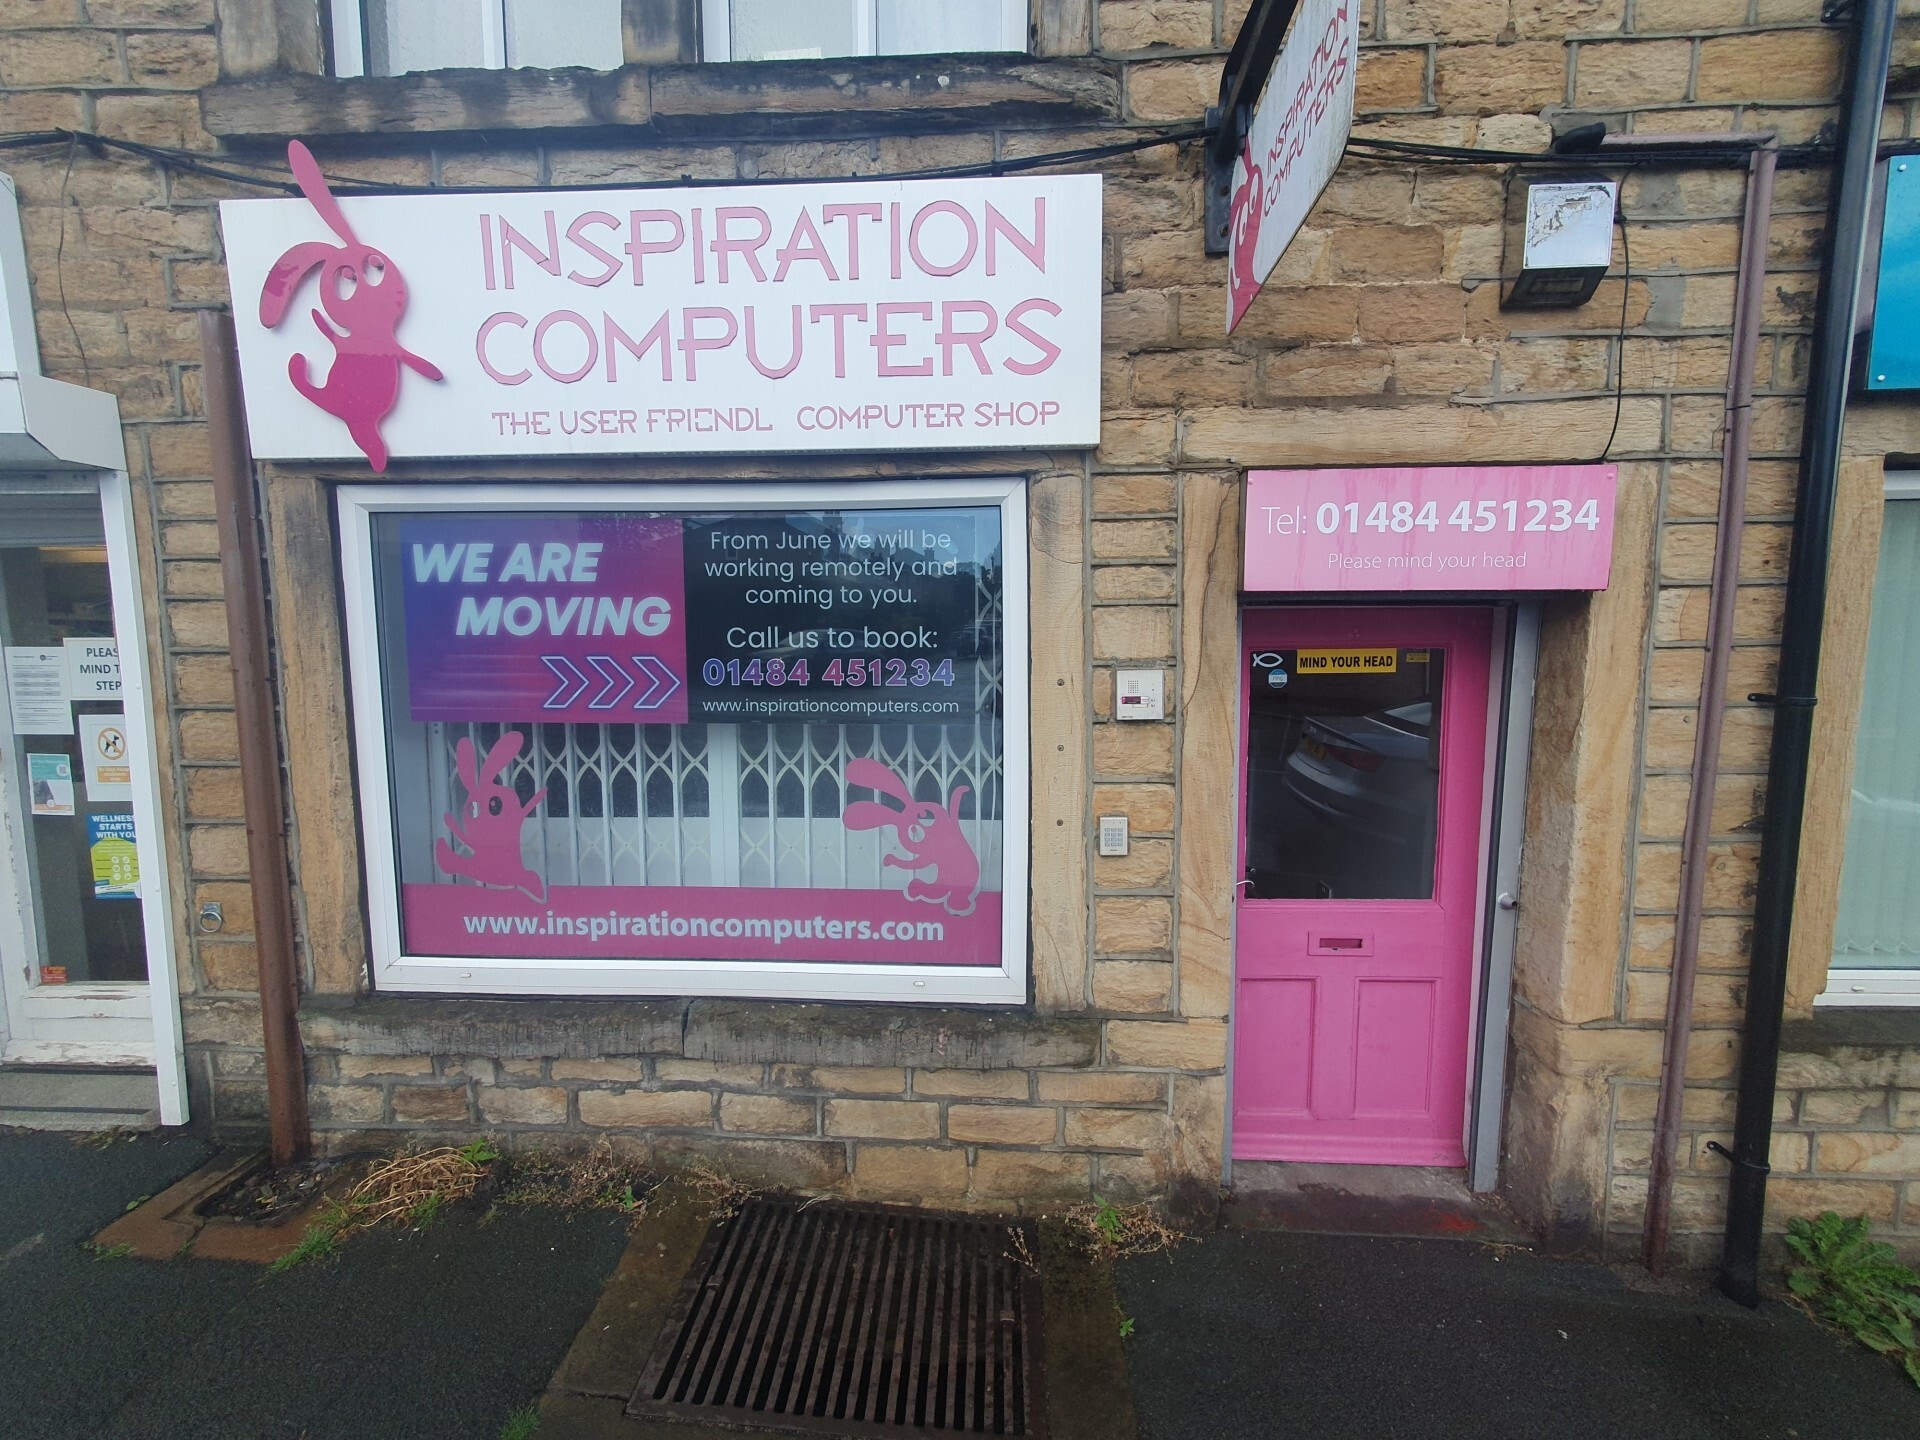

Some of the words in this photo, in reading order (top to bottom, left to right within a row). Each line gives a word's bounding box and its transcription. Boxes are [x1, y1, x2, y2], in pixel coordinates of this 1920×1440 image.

[1266, 0, 1349, 178] INSPIRATION
[1263, 36, 1349, 218] COMPUTERS
[480, 197, 1046, 290] INSPIRATION
[476, 298, 1063, 385] COMPUTERS
[491, 411, 551, 435] THE
[559, 409, 638, 434] USER
[797, 403, 965, 430] COMPUTER
[974, 401, 1060, 427] SHOP
[1261, 506, 1308, 535] Tel:
[1316, 501, 1440, 534] 01484
[1447, 499, 1600, 532] 451234
[710, 531, 768, 549] From
[776, 531, 831, 549] June
[839, 536, 871, 549] we
[879, 529, 914, 548] will
[922, 530, 951, 548] be
[412, 543, 494, 582] WE
[498, 543, 603, 582] ARE
[704, 558, 794, 582] working
[801, 557, 904, 581] remotely
[912, 557, 957, 576] and
[1328, 553, 1383, 570] Please
[1387, 552, 1433, 568] mind
[1438, 556, 1478, 572] your
[1482, 552, 1527, 568] head
[745, 585, 832, 609] coming
[840, 587, 863, 604] to
[869, 588, 917, 609] you.
[456, 597, 671, 636] MOVING
[727, 626, 779, 648] Call
[788, 631, 819, 648] us
[828, 629, 854, 648] to
[864, 626, 938, 648] book:
[86, 647, 119, 658] PLEAS
[1299, 656, 1327, 669] MIND
[1331, 656, 1361, 668] YOUR
[1364, 655, 1393, 667] HEAD
[79, 664, 112, 674] MIND
[702, 658, 810, 687] 01484
[822, 658, 955, 687] 451234
[96, 680, 122, 691] STEP
[702, 698, 959, 716] www.inspirationcomputers.com
[96, 831, 117, 839] WITH
[99, 823, 133, 831] STARTS
[463, 911, 944, 944] www.inspirationcomputers.com
